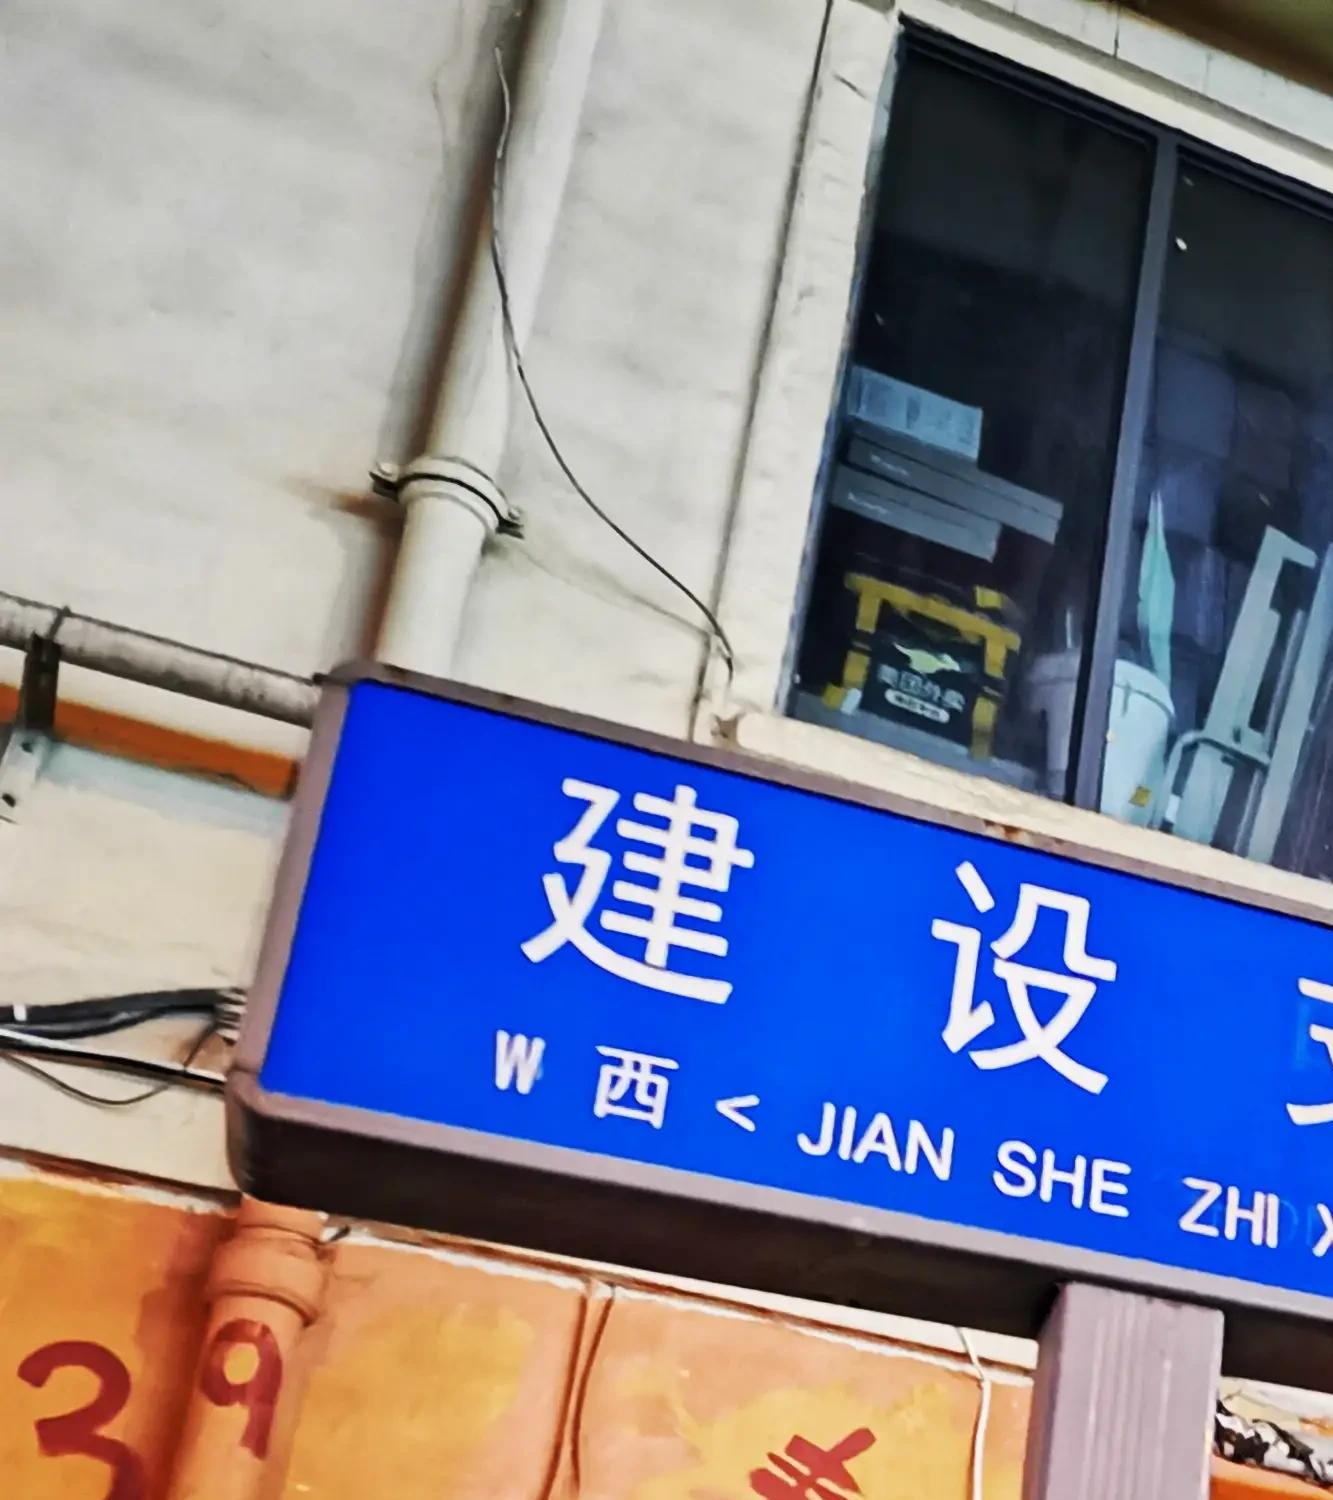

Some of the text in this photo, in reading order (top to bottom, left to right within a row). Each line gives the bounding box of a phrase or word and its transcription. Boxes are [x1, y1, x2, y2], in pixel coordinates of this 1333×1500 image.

[493, 1028, 543, 1095] W
[593, 1044, 681, 1131] 西
[796, 1099, 956, 1184] JIAN
[993, 1141, 1131, 1221] SHE
[1179, 1176, 1280, 1248] ZHI
